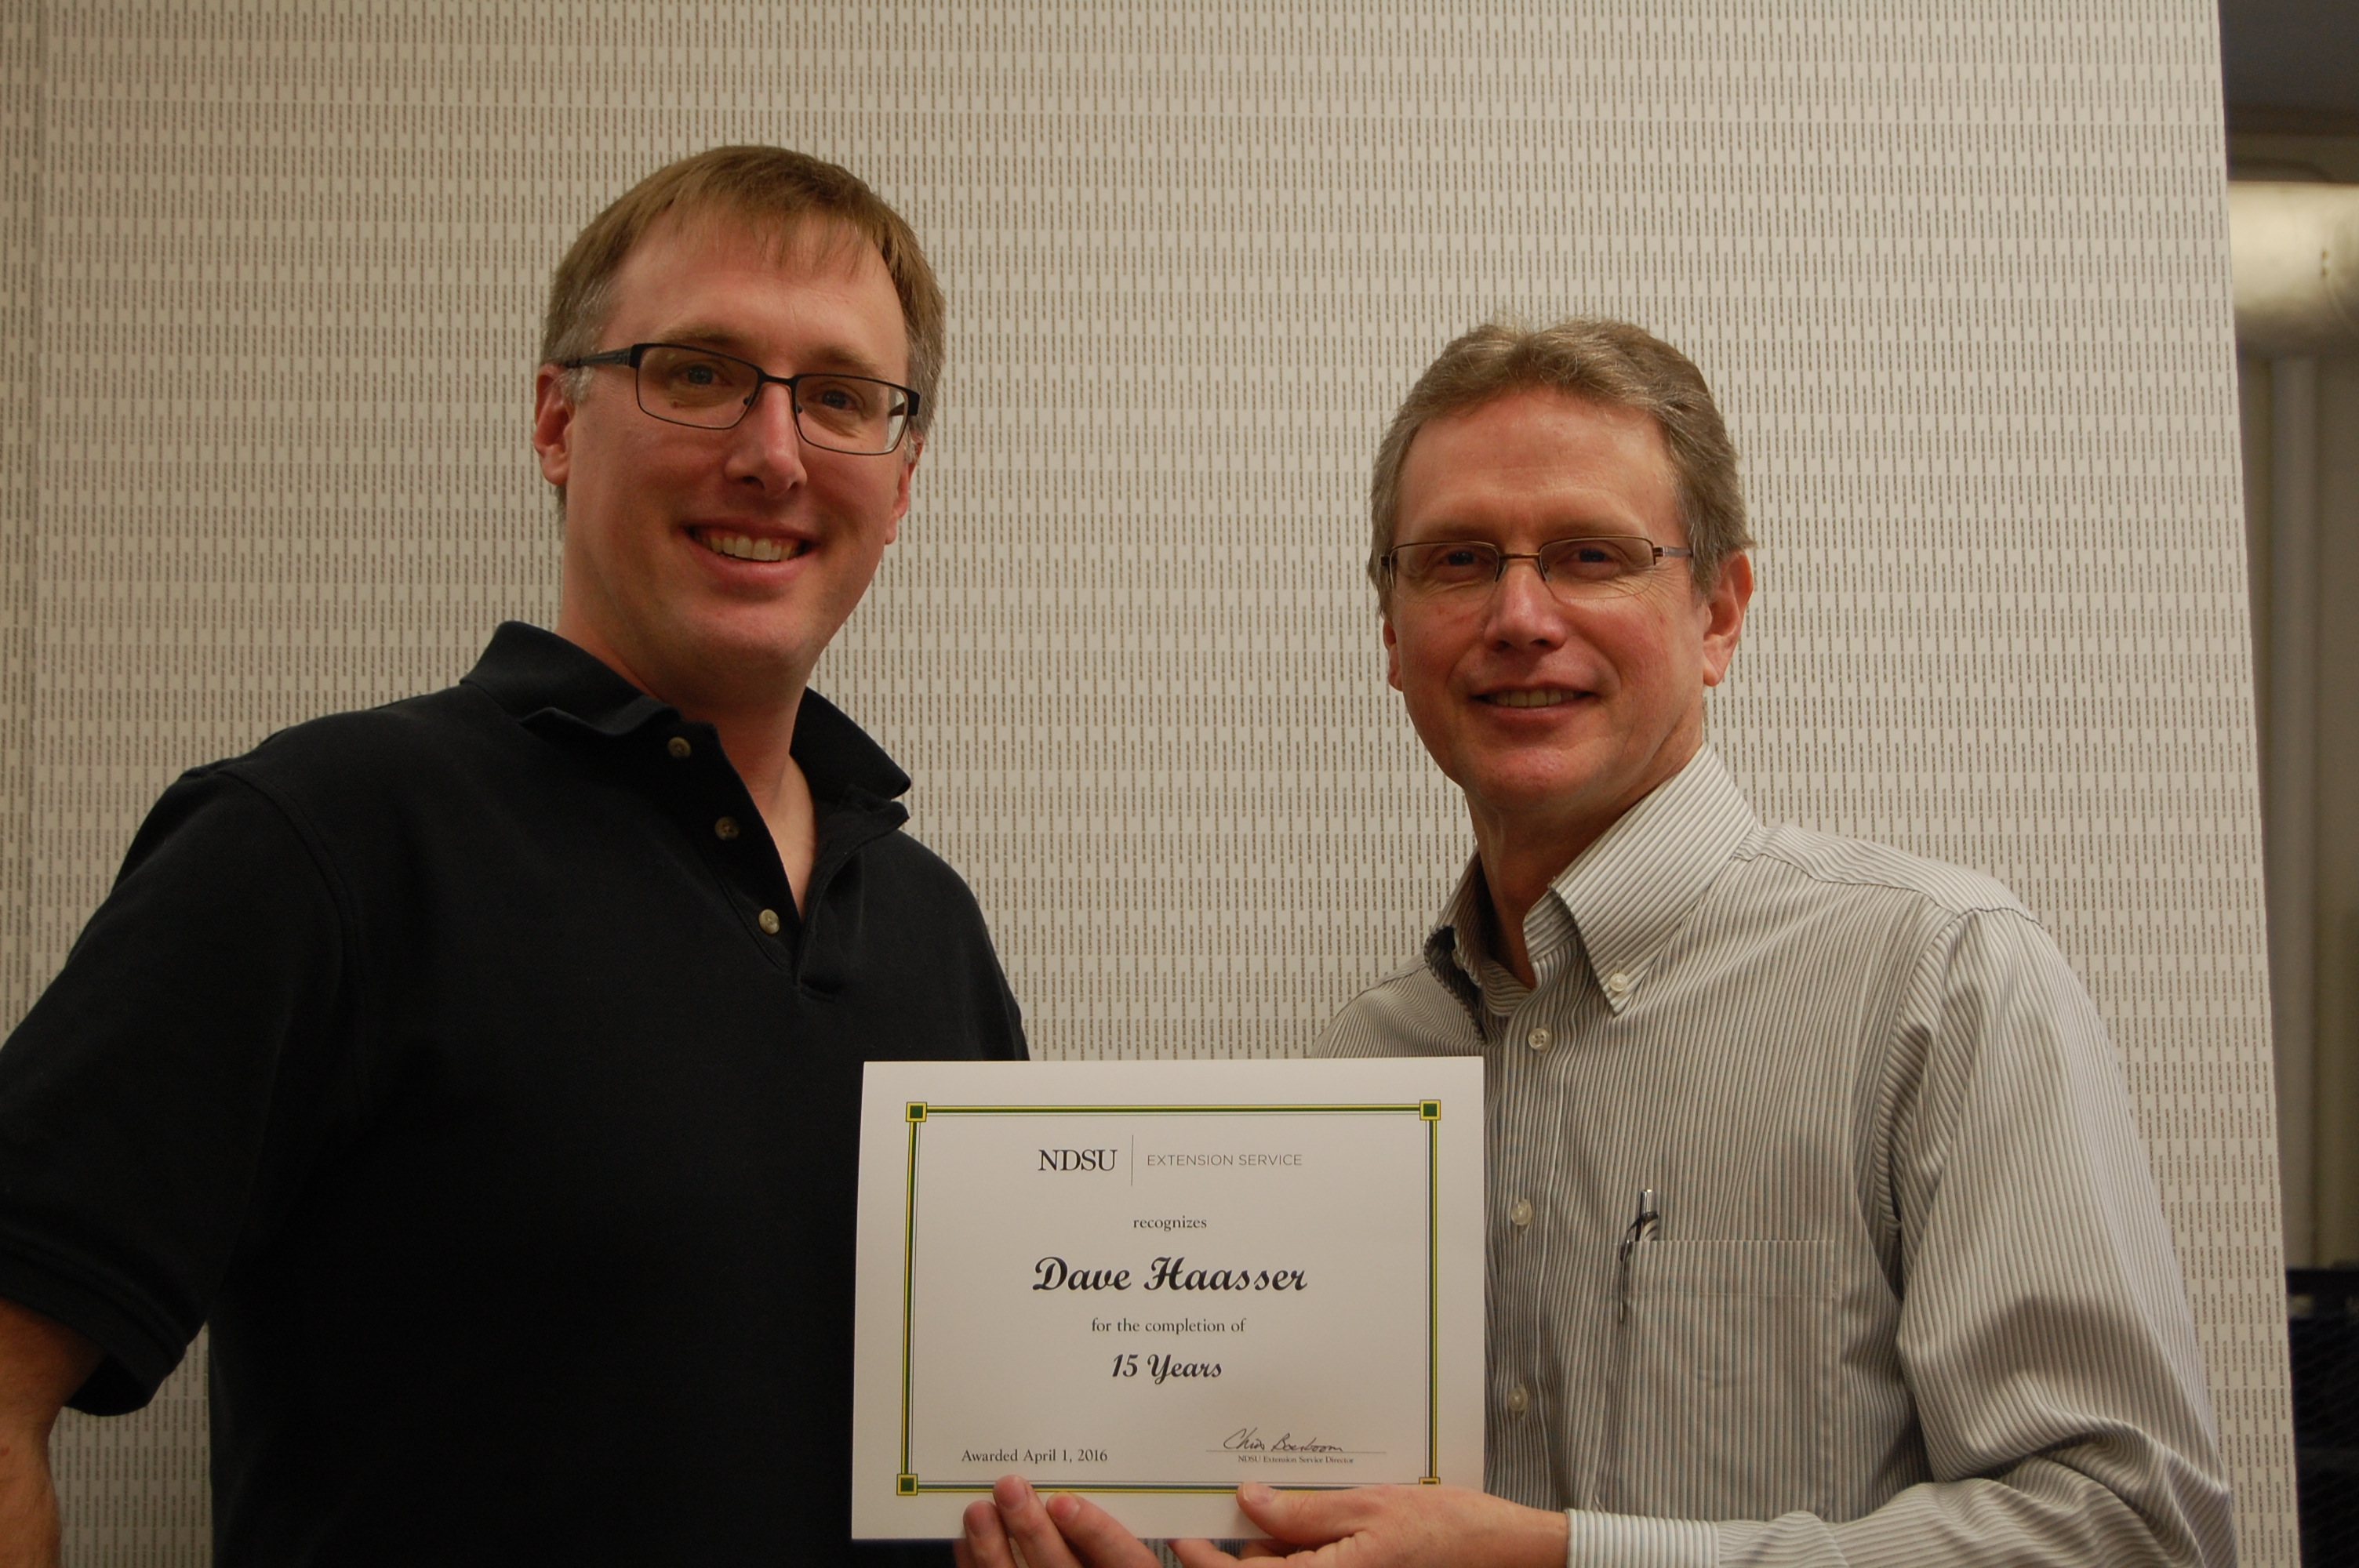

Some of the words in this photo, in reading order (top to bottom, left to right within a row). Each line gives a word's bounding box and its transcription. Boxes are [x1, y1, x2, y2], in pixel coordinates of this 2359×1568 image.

[1038, 1149, 1118, 1172] NDSU
[1147, 1154, 1234, 1167] EXTENSION
[1238, 1154, 1303, 1167] SERVICE
[1132, 1214, 1208, 1232] recognizes
[1032, 1256, 1132, 1291] Dave
[1143, 1256, 1309, 1291] Haasser
[1092, 1317, 1112, 1332] for
[1117, 1317, 1140, 1332] the
[1144, 1317, 1226, 1336] completion
[1230, 1317, 1247, 1332] of
[1111, 1353, 1139, 1377] 15
[1147, 1353, 1223, 1385] Years
[961, 1448, 1018, 1463] Awarded
[1022, 1448, 1056, 1465] April
[1062, 1449, 1074, 1465] 1,
[1078, 1448, 1109, 1463] 2016
[1238, 1455, 1261, 1464] NDSU
[1263, 1455, 1297, 1465] Extension
[1299, 1456, 1324, 1465] Service
[1325, 1456, 1354, 1465] Director
